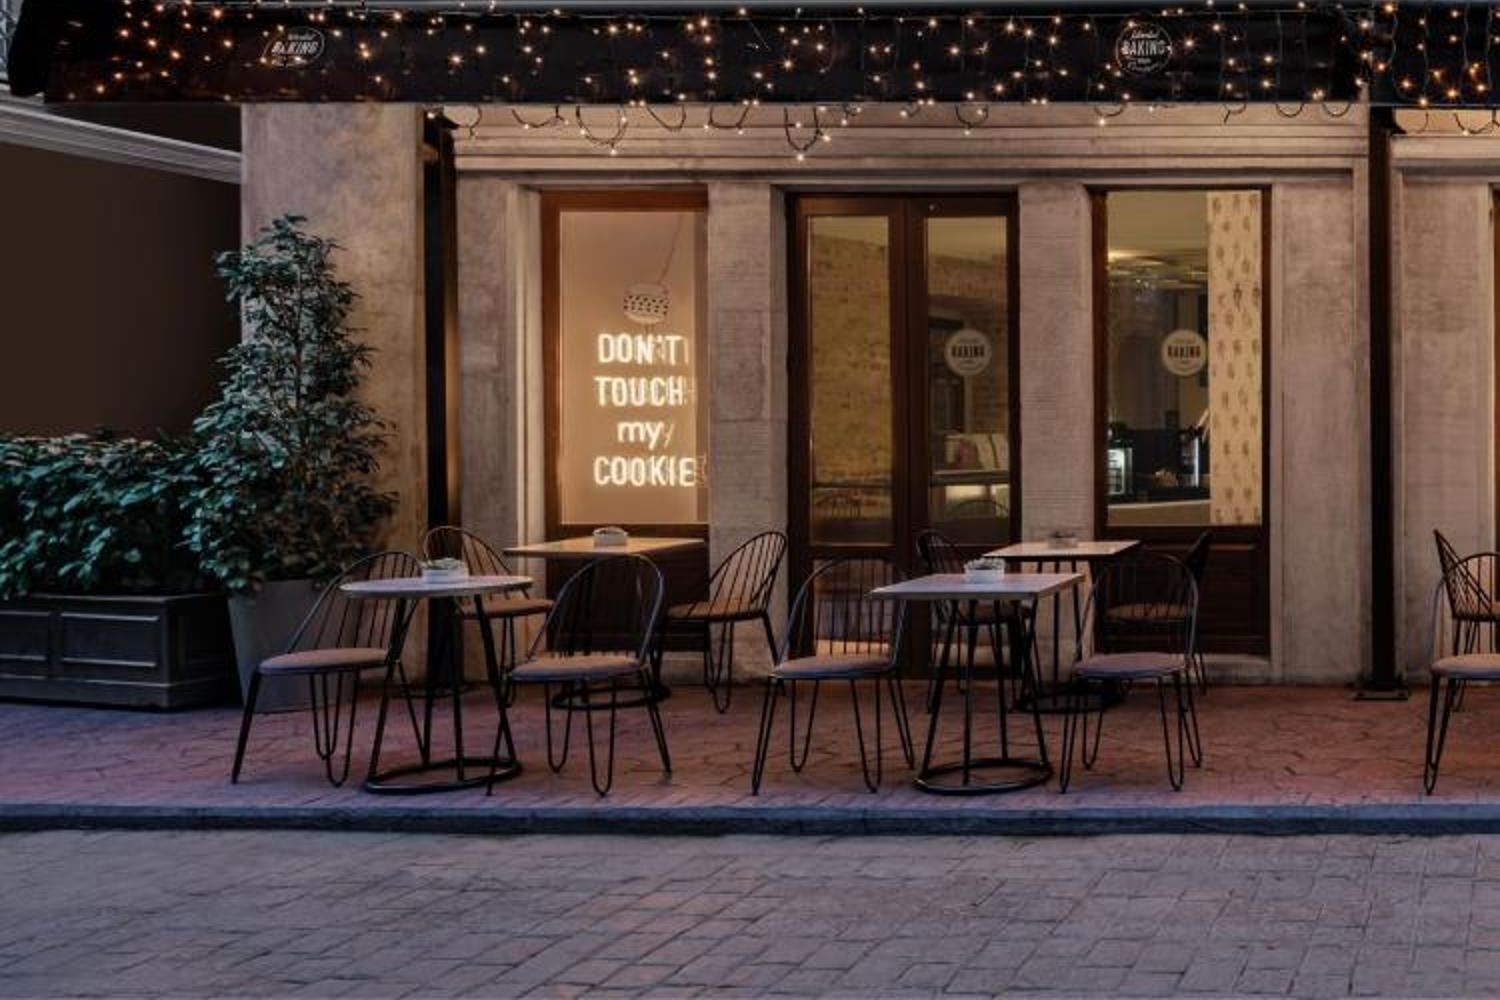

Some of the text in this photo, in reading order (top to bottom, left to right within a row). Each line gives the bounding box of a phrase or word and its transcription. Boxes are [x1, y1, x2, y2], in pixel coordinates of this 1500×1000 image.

[598, 333, 683, 365] DON'T
[594, 376, 684, 407] TOUCH
[617, 421, 665, 450] my
[594, 456, 697, 487] COOKIE
